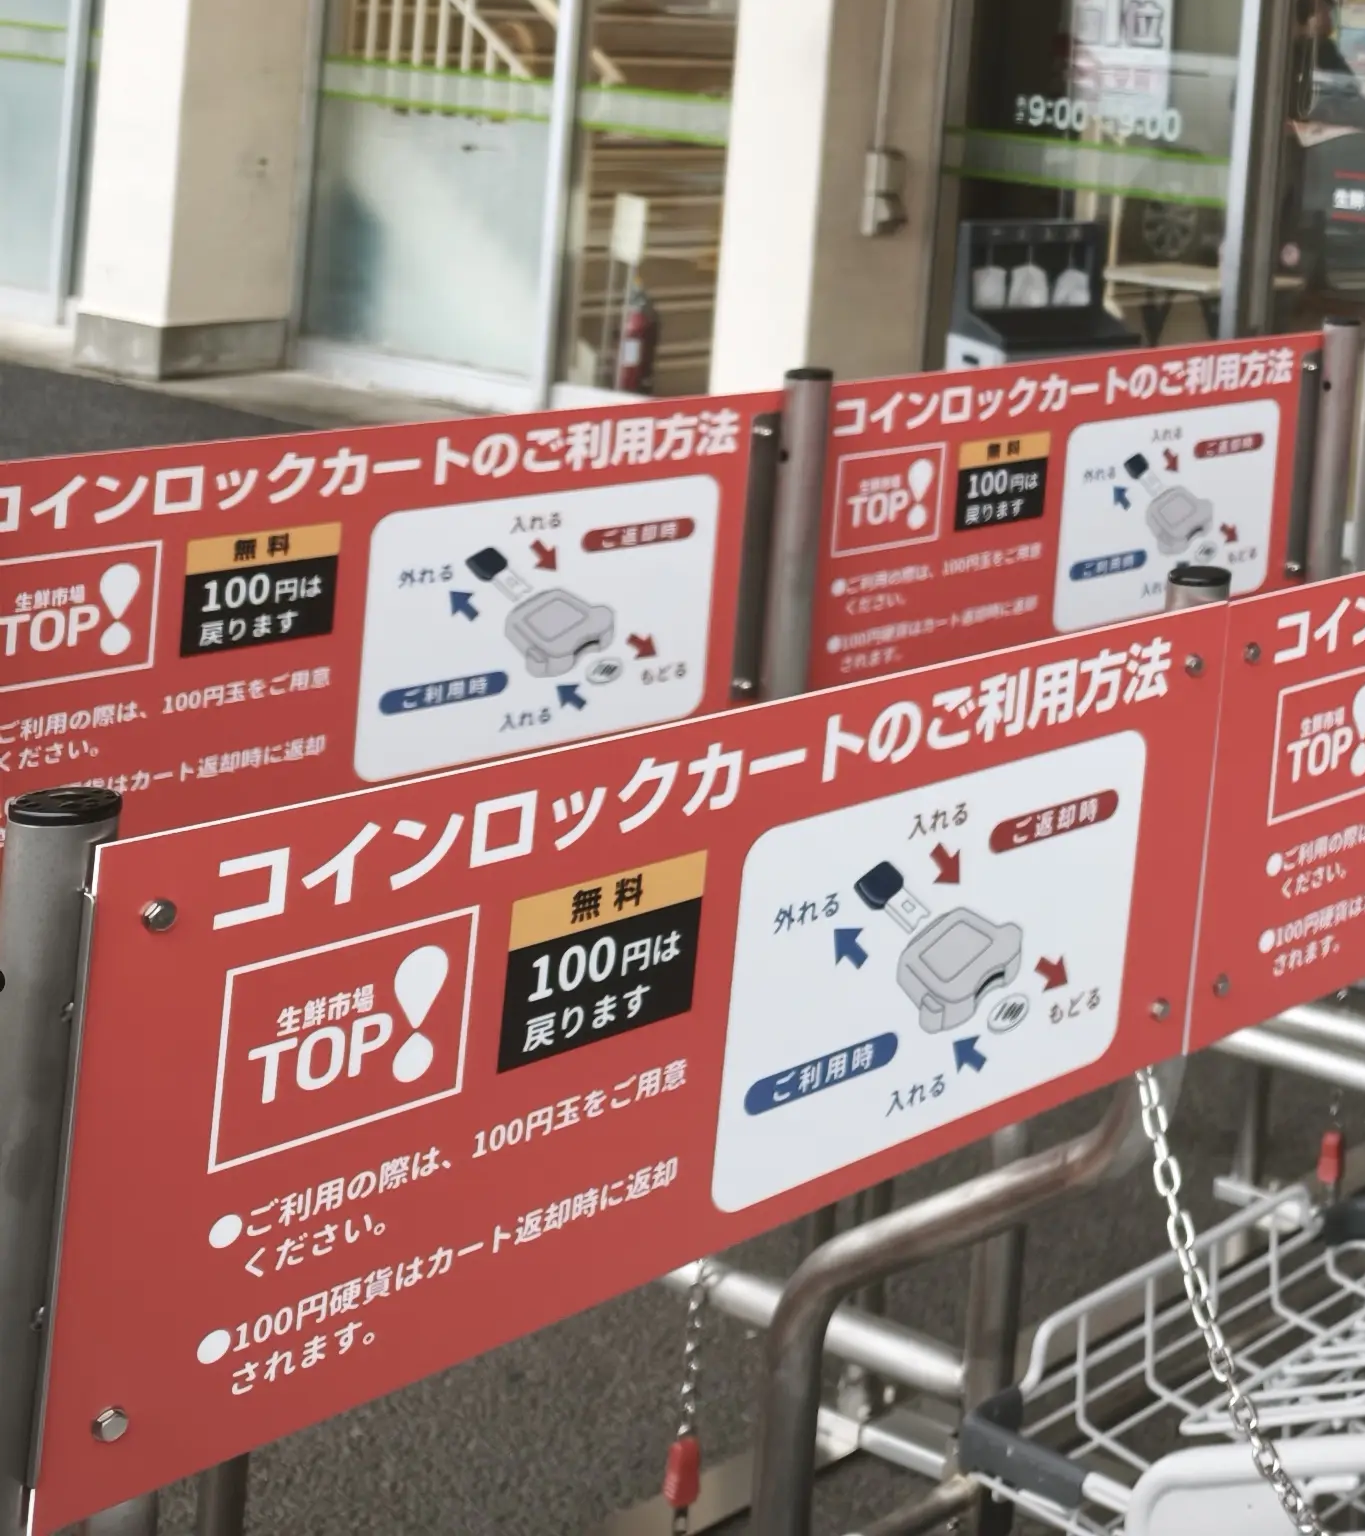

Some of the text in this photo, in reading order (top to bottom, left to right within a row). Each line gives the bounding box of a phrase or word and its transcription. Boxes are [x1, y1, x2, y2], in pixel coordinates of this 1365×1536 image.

[833, 347, 1294, 437] コインロックカートのご利用方法
[967, 469, 1039, 499] 100円は
[510, 513, 562, 534] 入れる
[965, 499, 1024, 526] 戻ります
[232, 534, 290, 561] 無料
[201, 574, 323, 613] 100円は
[398, 565, 453, 588] 外れる
[199, 609, 299, 646] 戻ります
[402, 677, 489, 709] ご利用時
[641, 662, 687, 686] もどる
[499, 708, 552, 732] 入れる
[212, 636, 1171, 931] コインロックカートのご利用方法
[907, 802, 969, 840] 入れる
[1012, 797, 1100, 843] ご返却時
[570, 873, 644, 924] 無料
[773, 892, 841, 936] 外れる
[527, 930, 681, 1004] 100円は
[276, 984, 374, 1034] 生鮮市場
[521, 983, 652, 1053] 戻ります
[1048, 987, 1102, 1024] もどる
[771, 1043, 875, 1101] ご利用時
[885, 1074, 947, 1119] 入れる
[243, 1218, 387, 1279] ください。
[231, 1329, 377, 1396] されます。
